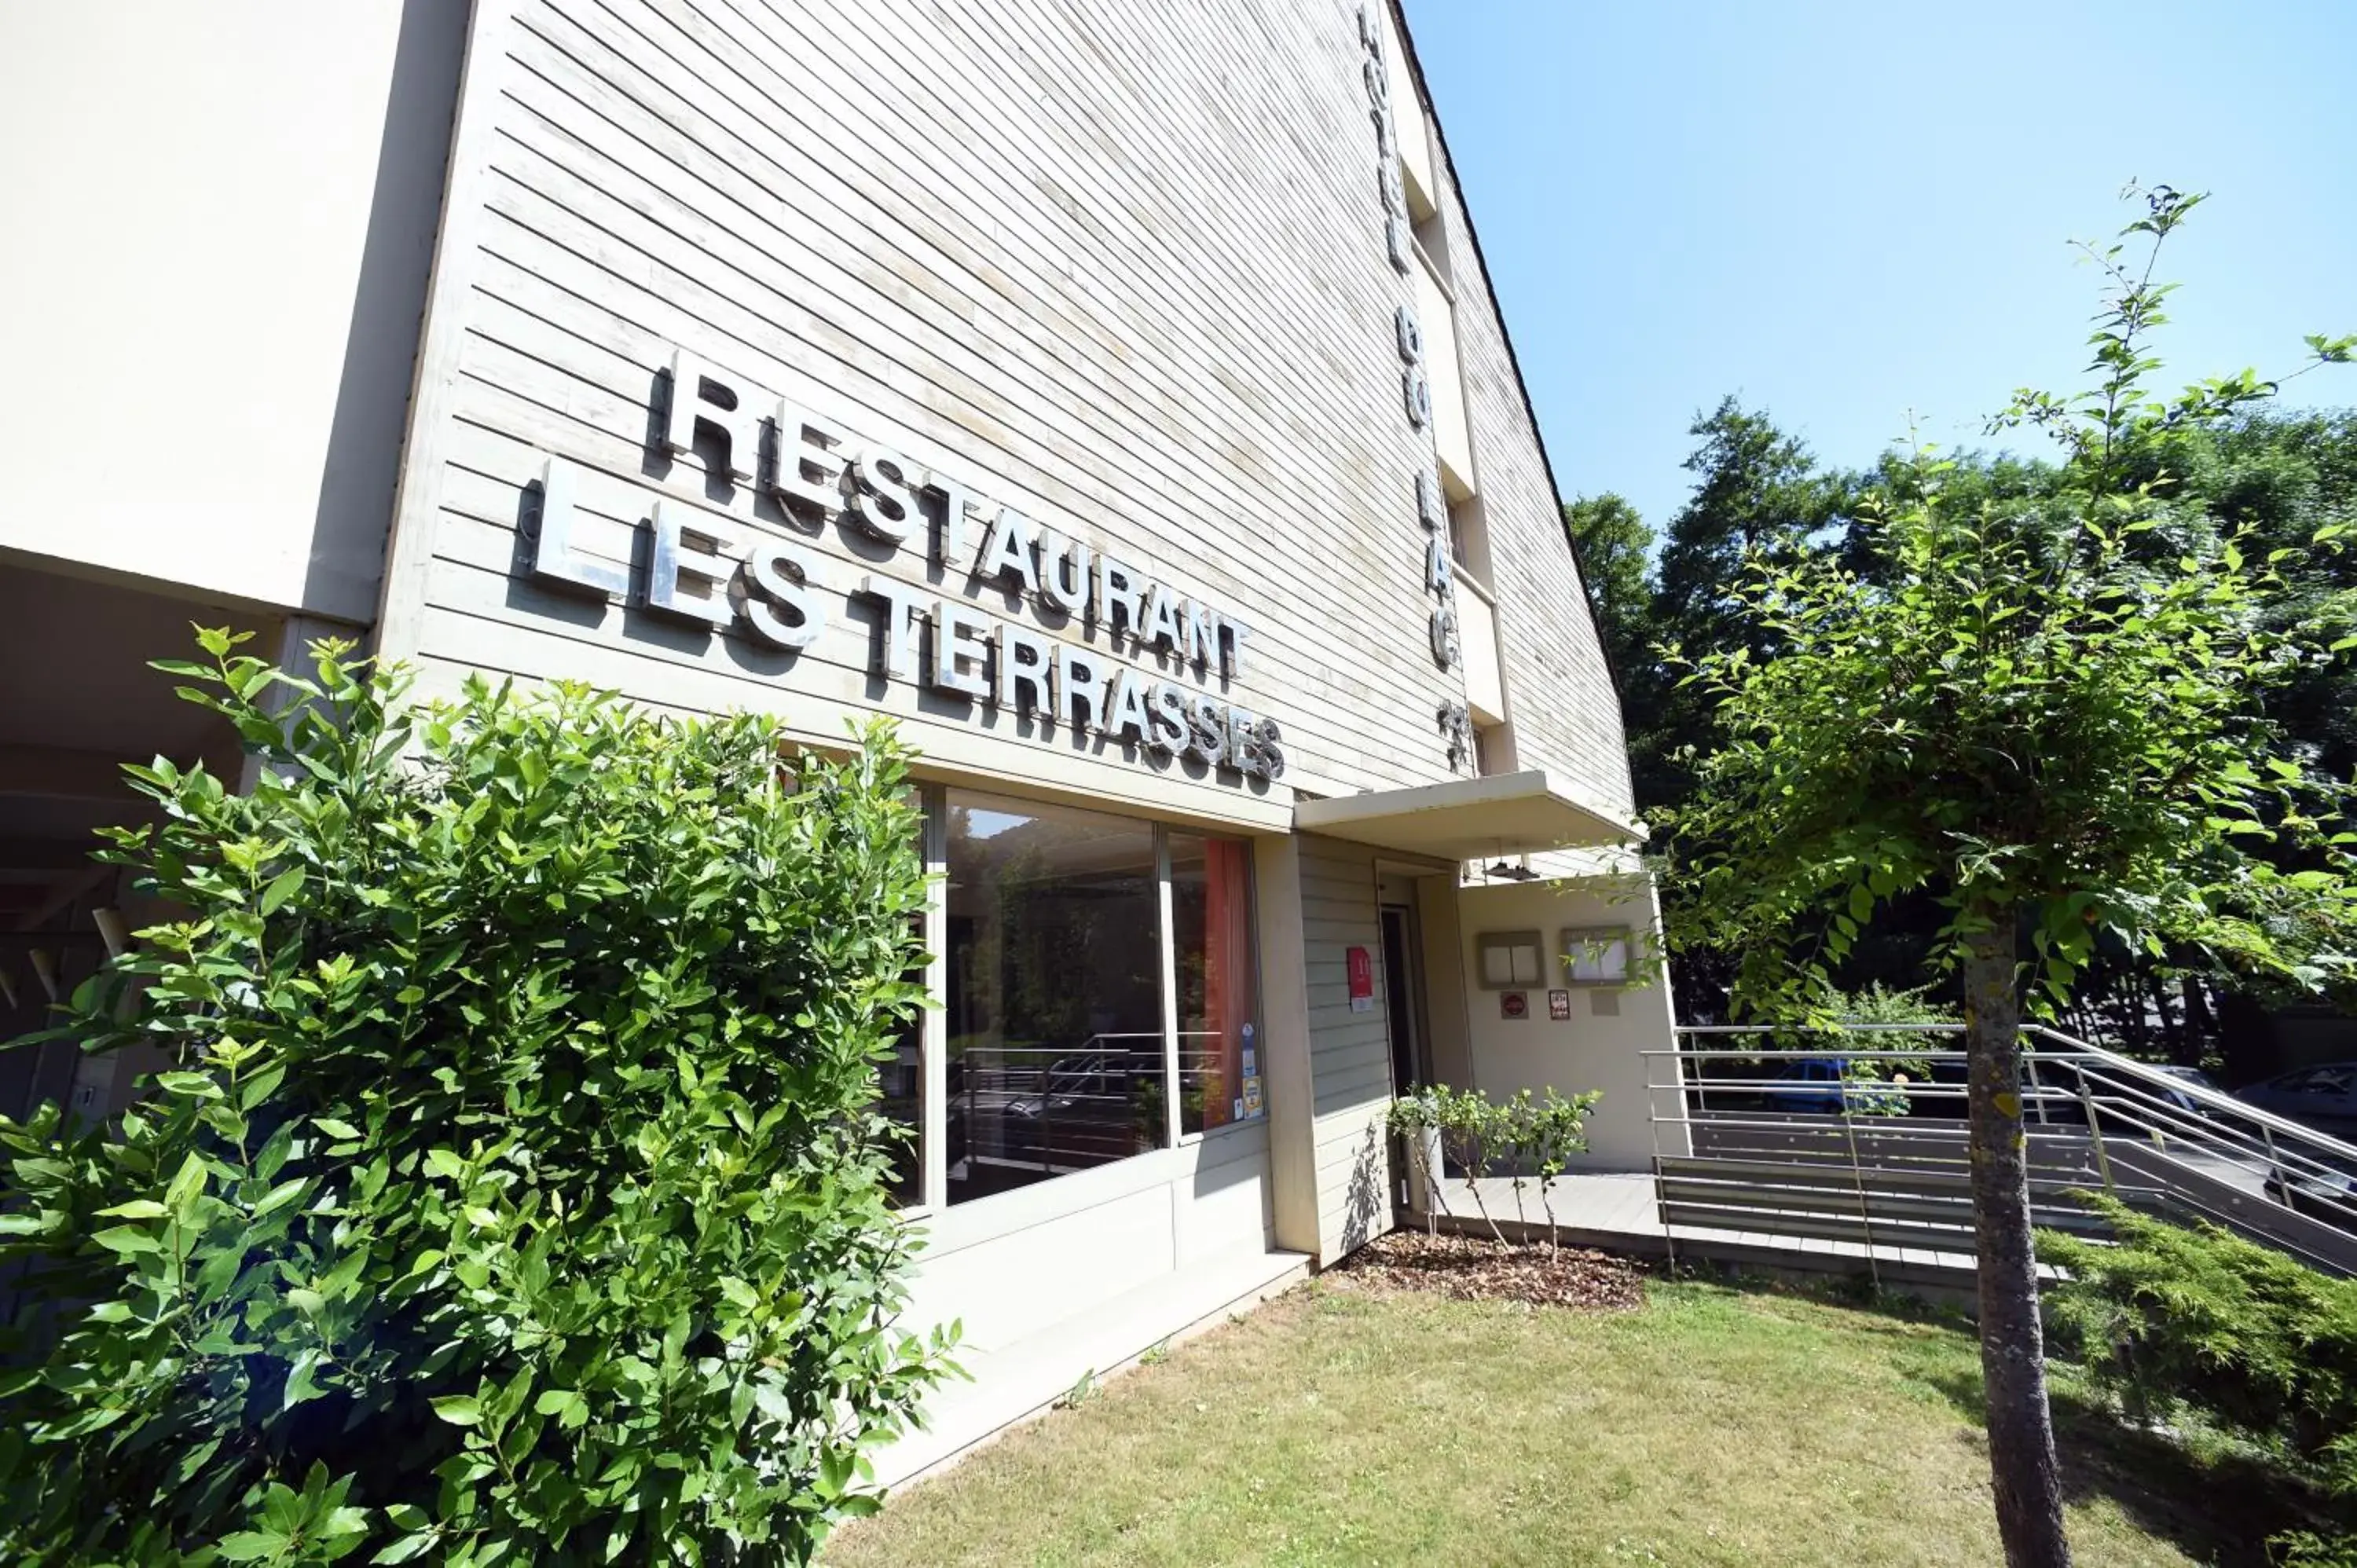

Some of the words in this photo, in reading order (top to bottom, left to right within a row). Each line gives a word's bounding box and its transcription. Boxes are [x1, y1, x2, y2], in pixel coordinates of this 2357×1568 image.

[535, 454, 827, 650] LES
[860, 575, 1285, 779] TERRASSES
[666, 348, 1252, 680] RESTAURANT
[1418, 469, 1459, 668] LAC
